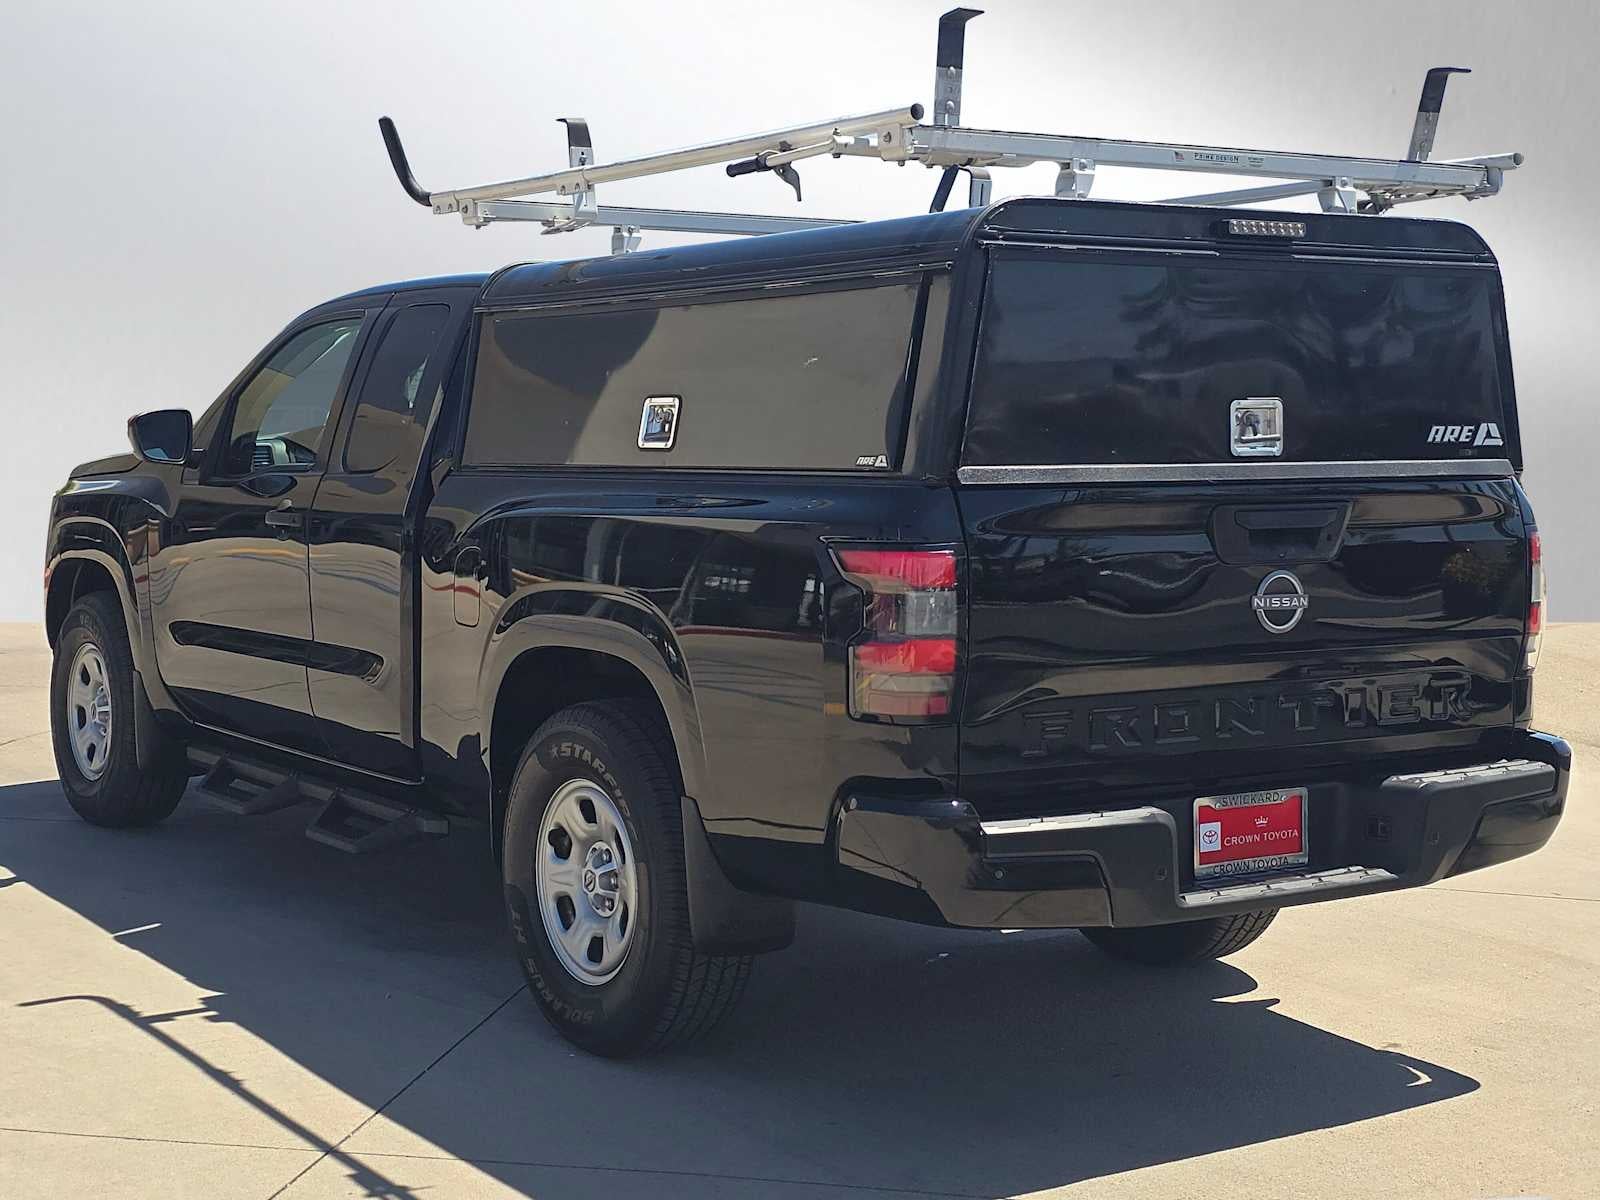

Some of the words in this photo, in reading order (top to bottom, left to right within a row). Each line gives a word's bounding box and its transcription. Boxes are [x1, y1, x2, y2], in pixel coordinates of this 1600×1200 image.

[1427, 425, 1475, 443] ARE
[1254, 597, 1308, 607] NISSAN
[1022, 671, 1474, 757] FRONTIER
[1223, 834, 1261, 847] CROWN
[1263, 829, 1299, 841] TOYOTA
[1213, 861, 1250, 875] CROWN
[1252, 856, 1289, 869] TOYOTA
